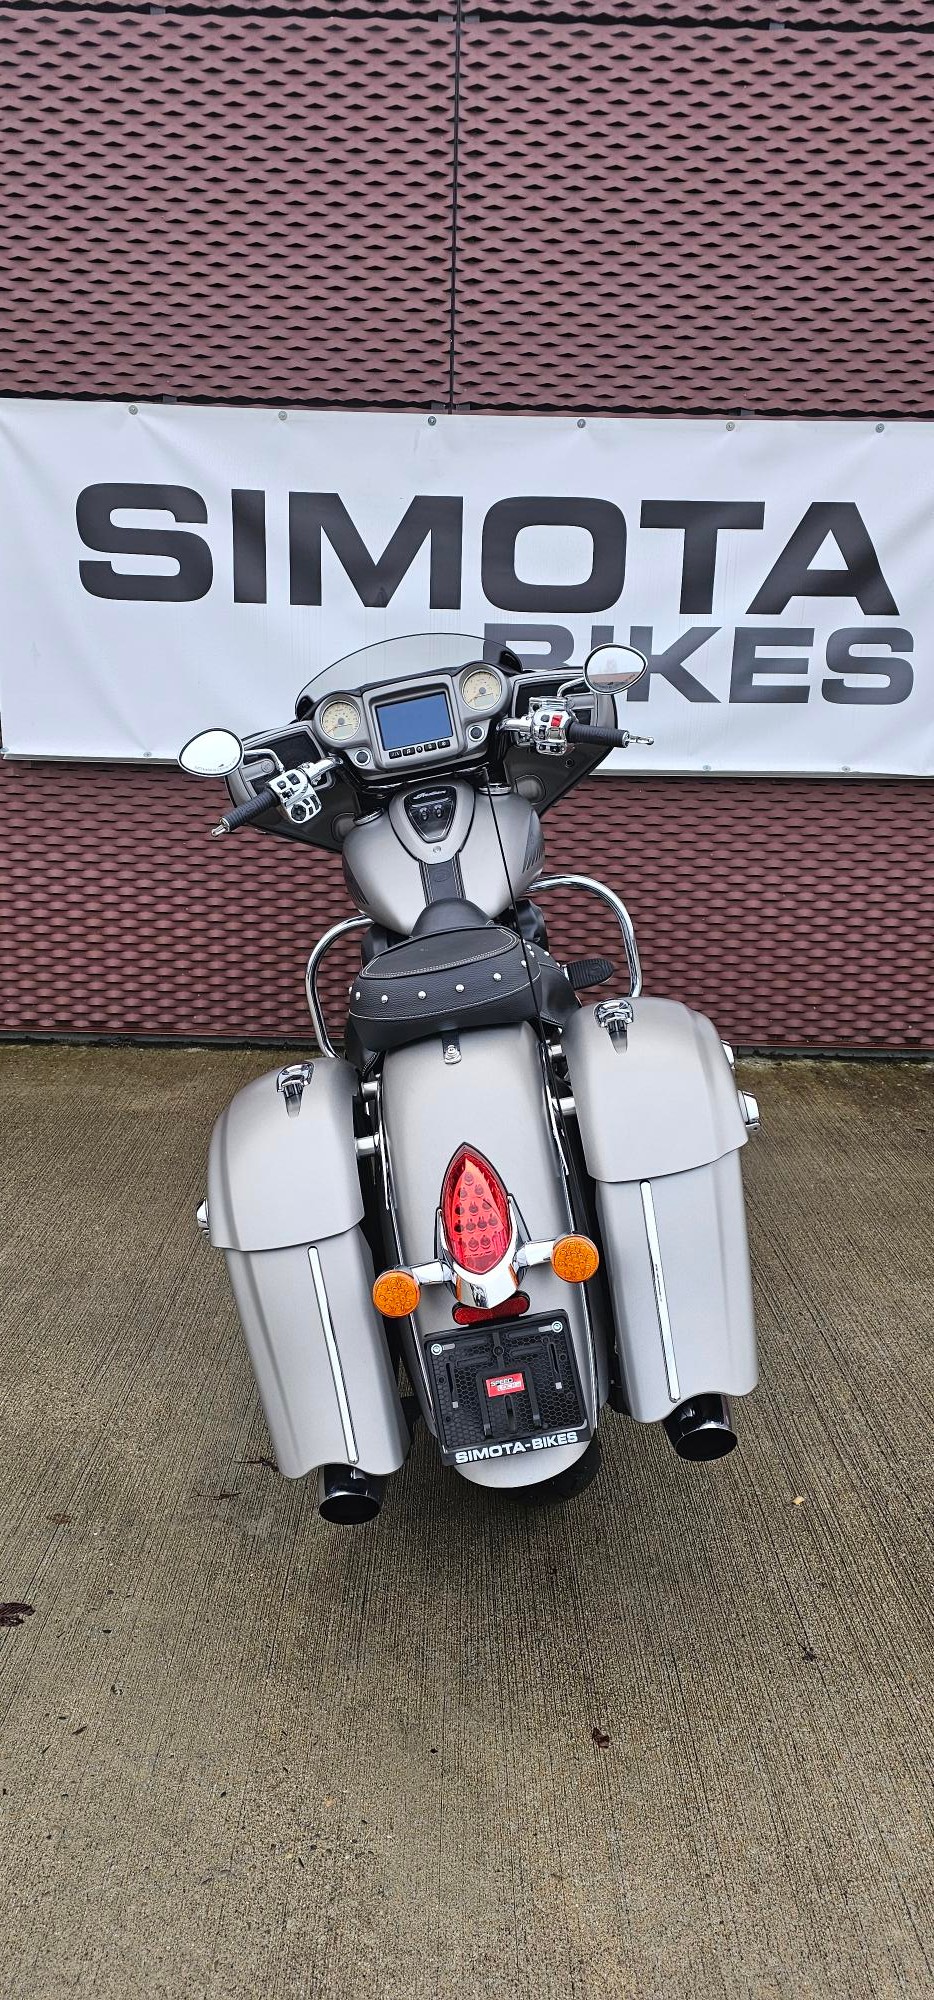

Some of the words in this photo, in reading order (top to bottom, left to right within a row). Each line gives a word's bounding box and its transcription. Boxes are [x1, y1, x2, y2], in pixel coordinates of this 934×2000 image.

[76, 482, 900, 616] SIMOTA
[483, 622, 914, 704] BKES
[455, 1431, 578, 1464] SIMOTA-BIKES
